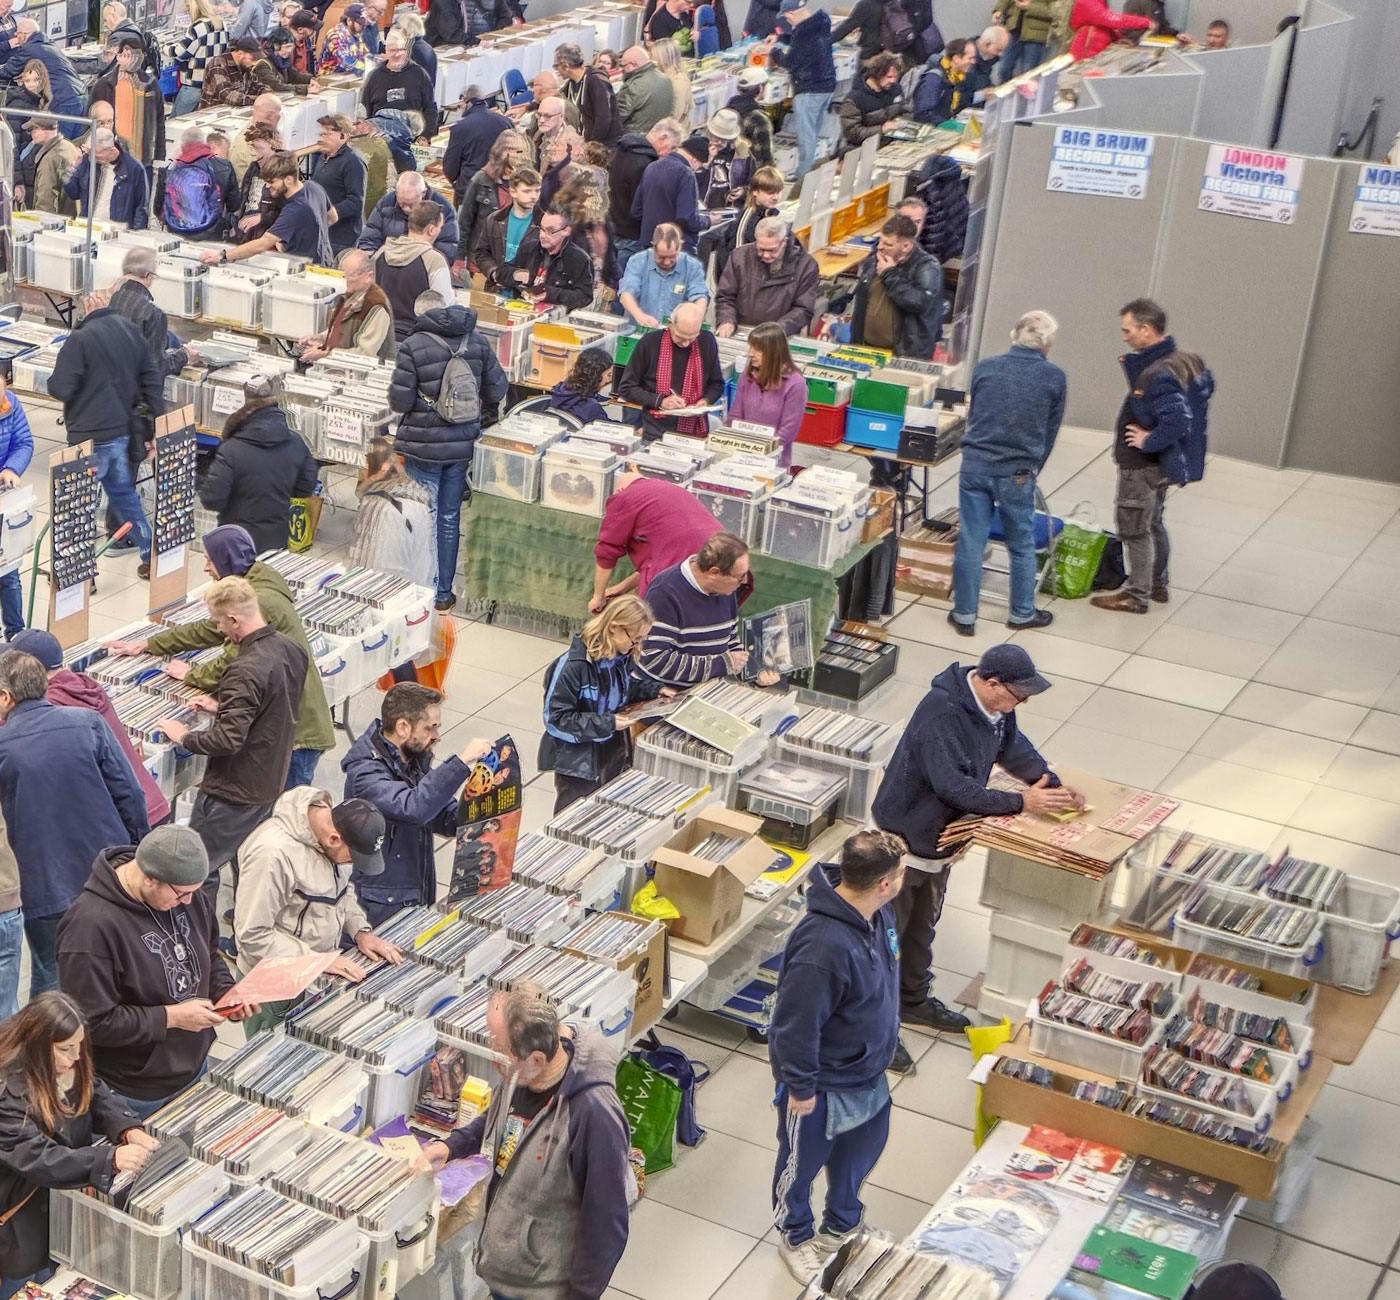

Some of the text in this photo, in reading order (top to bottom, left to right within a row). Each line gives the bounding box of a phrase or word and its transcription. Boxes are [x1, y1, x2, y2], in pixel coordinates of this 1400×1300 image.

[1061, 129, 1148, 153] BIG BRUM
[1055, 147, 1148, 169] RECORD FAIR
[1223, 147, 1287, 171] LONDON
[1220, 162, 1286, 186] Victoria
[1205, 177, 1295, 203] RECORD FAIR
[710, 435, 734, 448] Caught
[741, 441, 751, 449] the
